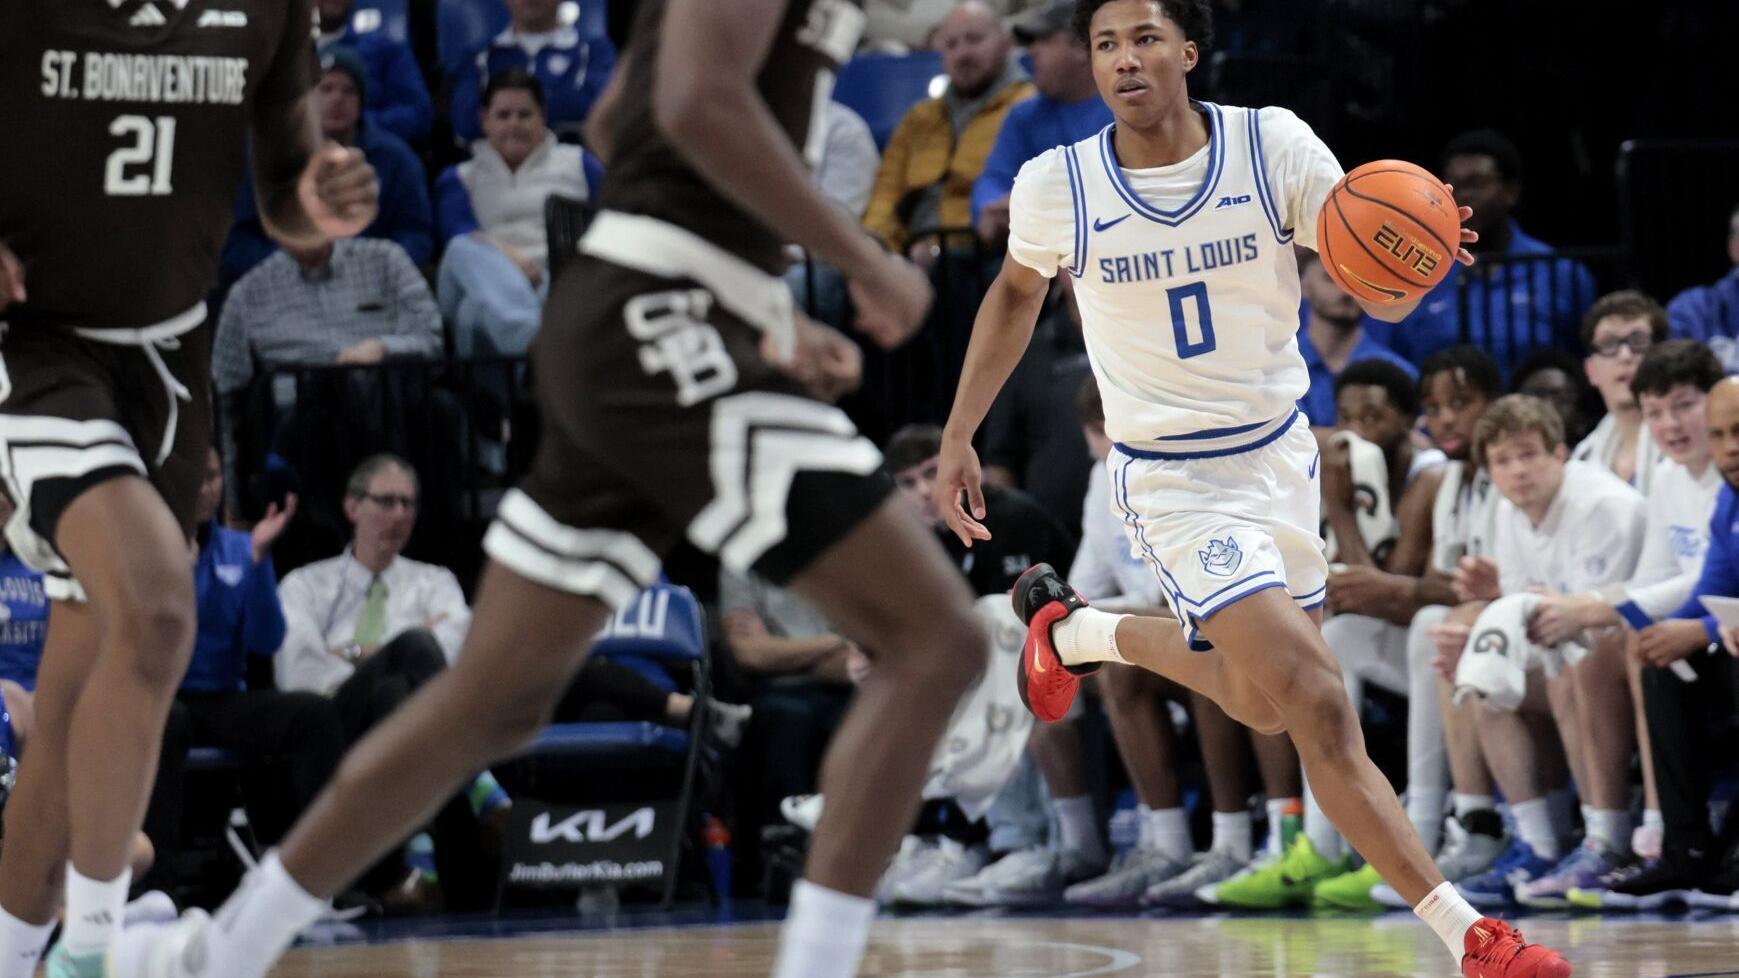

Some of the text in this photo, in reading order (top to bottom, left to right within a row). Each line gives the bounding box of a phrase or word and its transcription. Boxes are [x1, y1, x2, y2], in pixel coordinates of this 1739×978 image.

[41, 50, 248, 104] ST. BONAVENTURE
[104, 115, 176, 195] 21
[1099, 233, 1258, 283] SAINT LOUIS
[1372, 223, 1438, 278] ELITE
[1165, 281, 1217, 359] 0
